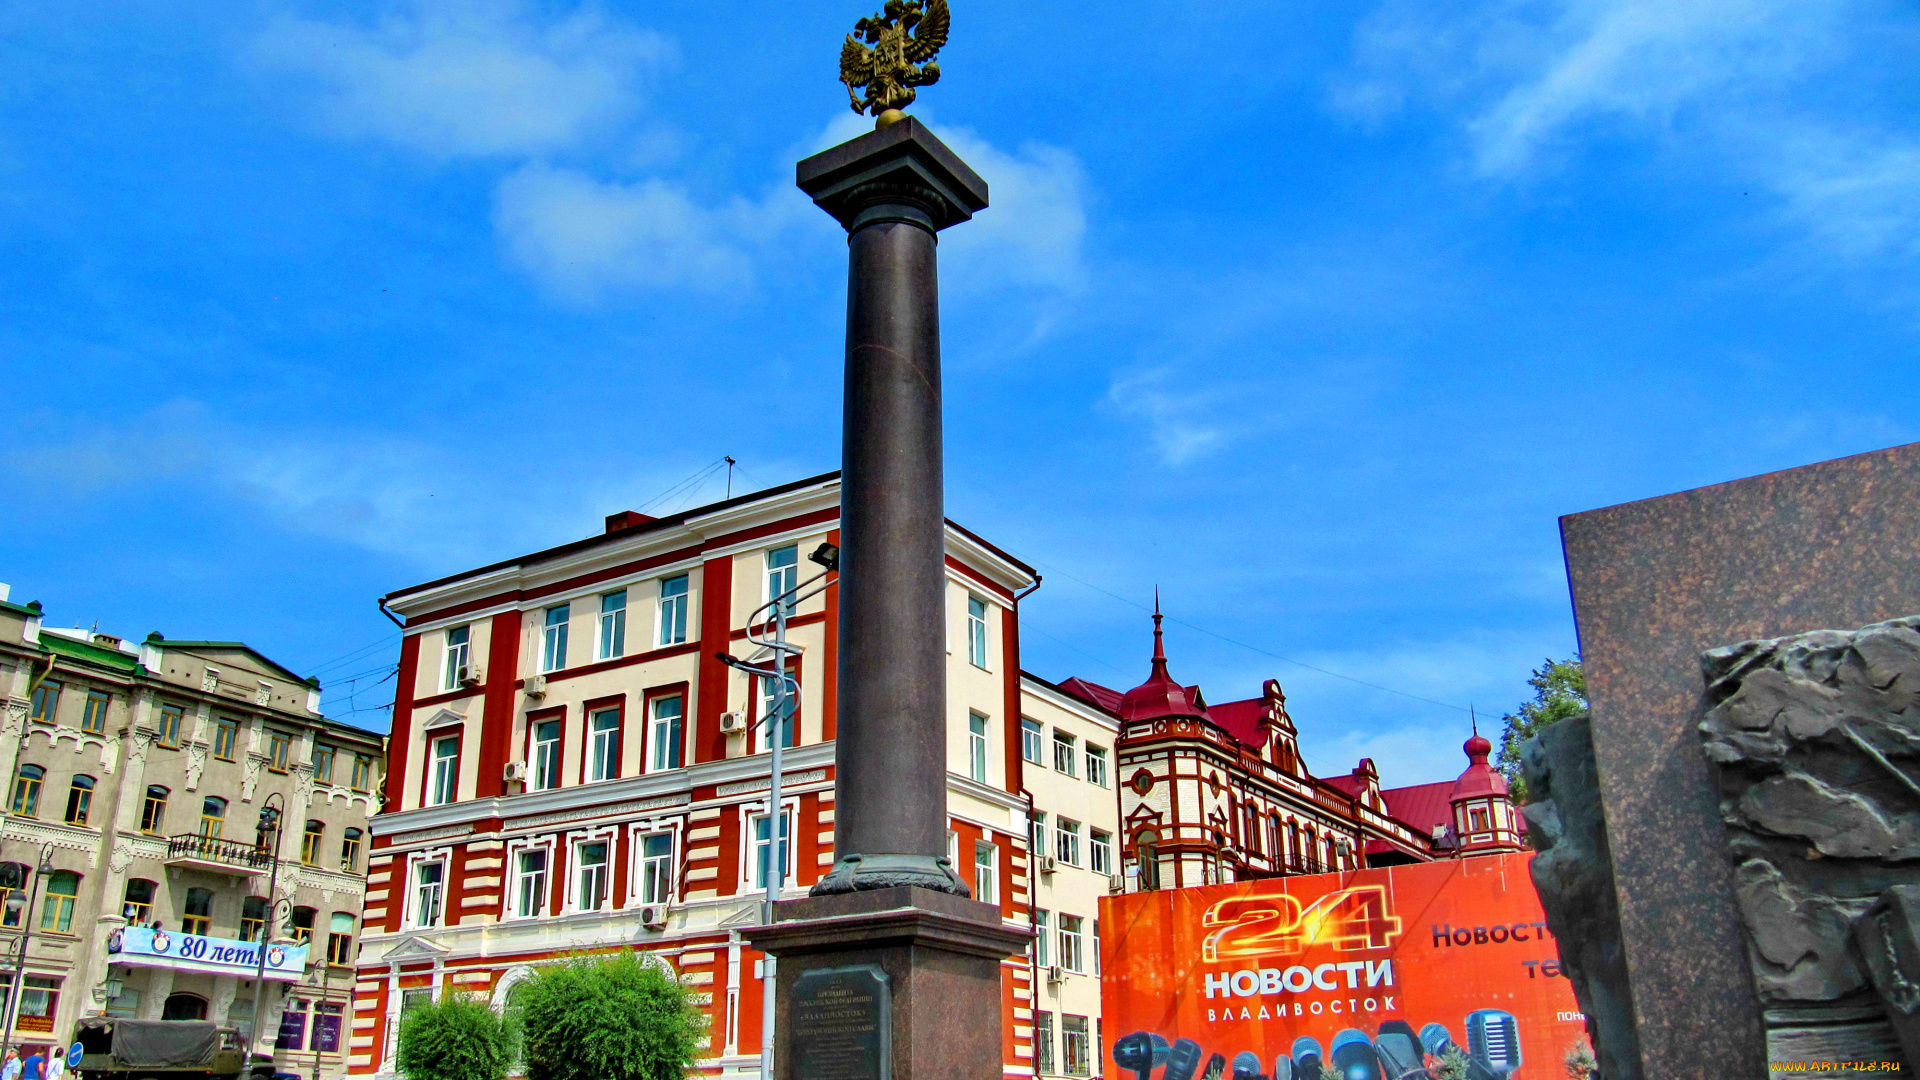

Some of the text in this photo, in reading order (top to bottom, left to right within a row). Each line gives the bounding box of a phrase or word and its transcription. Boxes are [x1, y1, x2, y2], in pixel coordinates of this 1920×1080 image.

[1203, 885, 1401, 963] 24
[1432, 922, 1555, 947] Новост
[180, 936, 262, 966] 80 лет!
[1205, 959, 1394, 999] НОВОСТИ
[1208, 996, 1396, 1022] ВЛАДИВОСТОК
